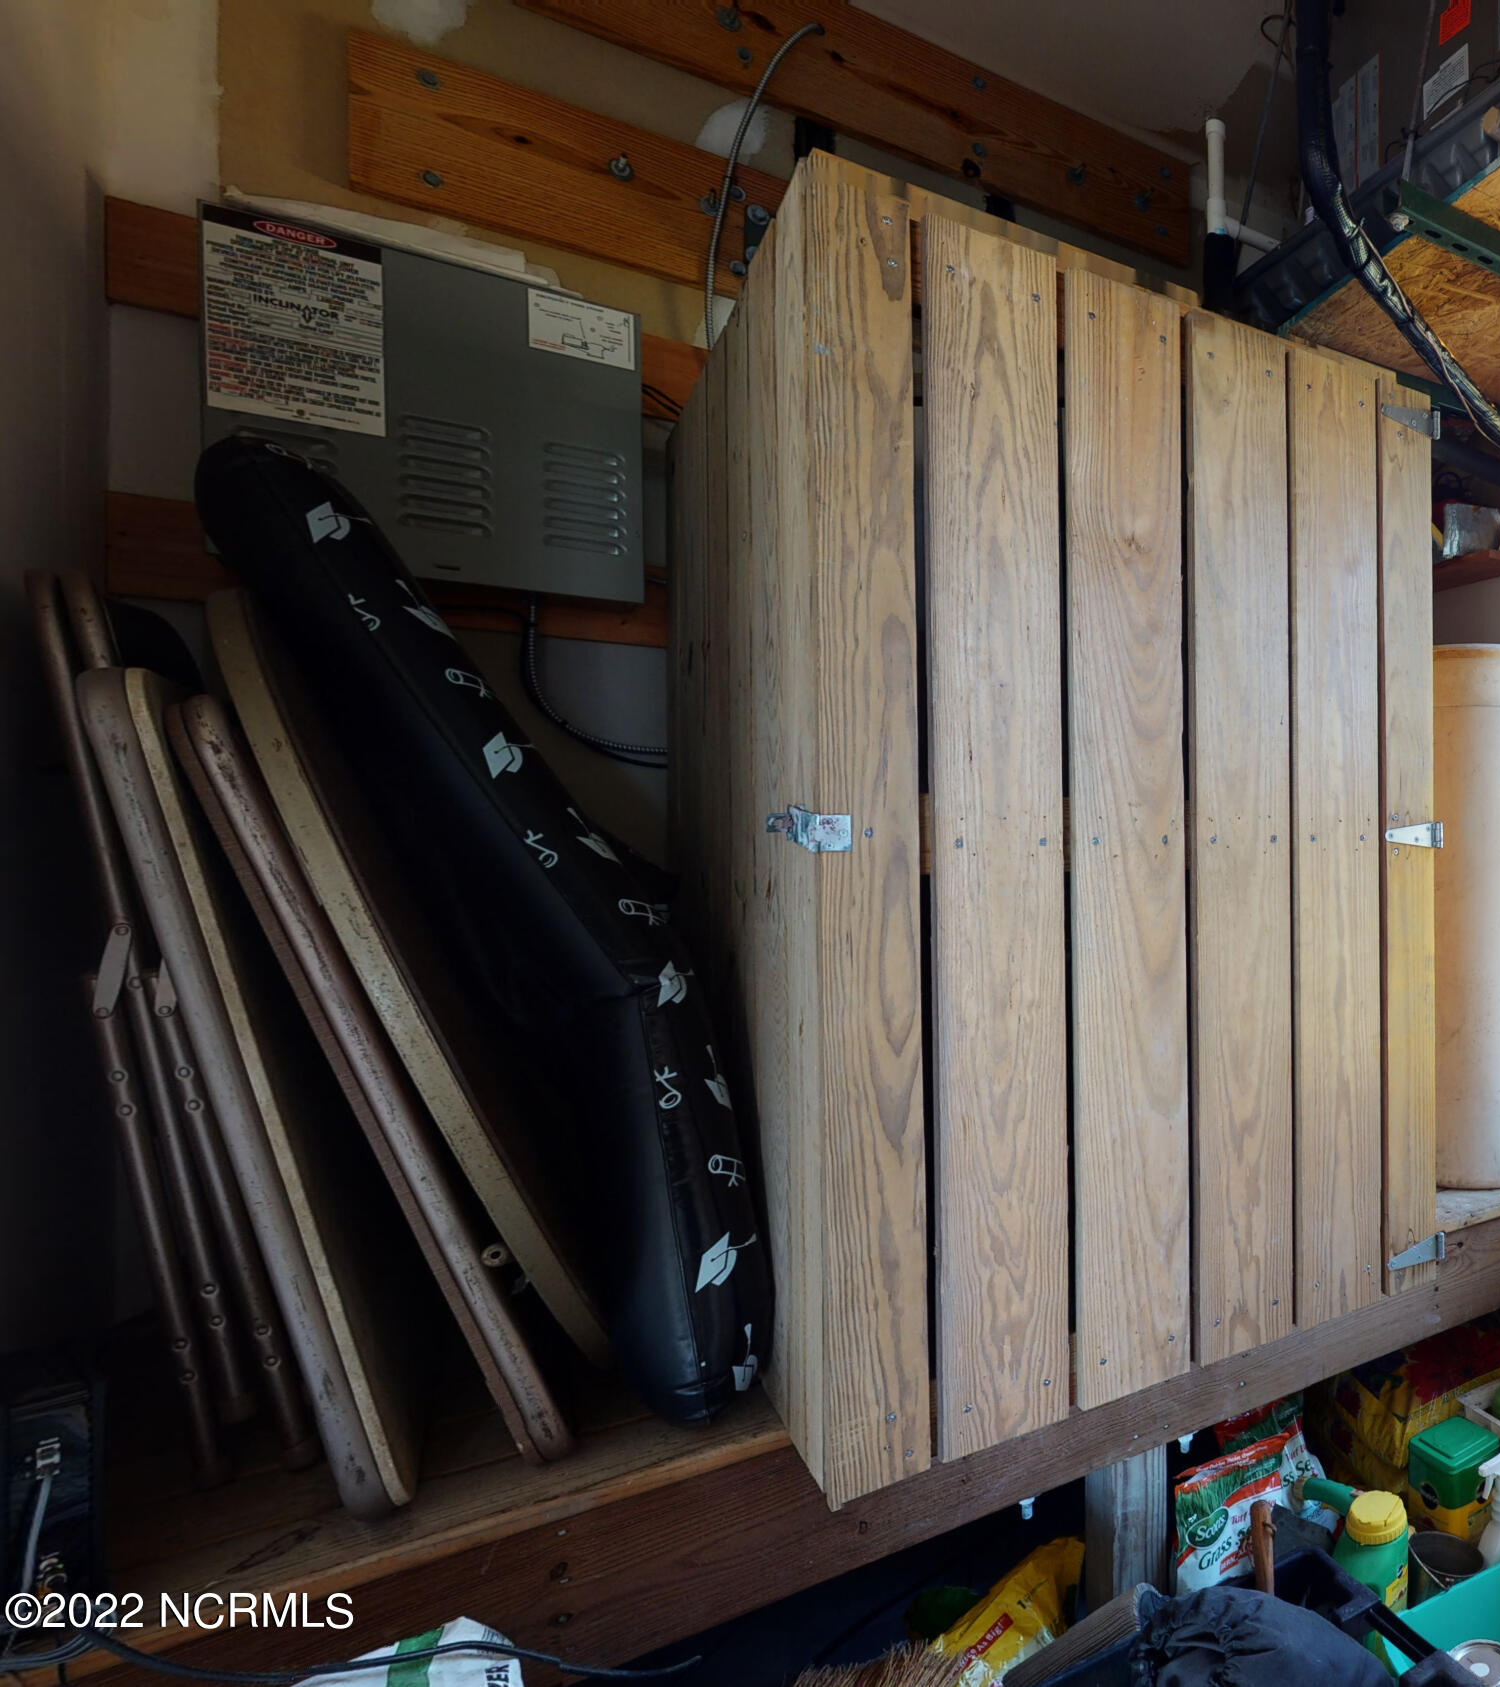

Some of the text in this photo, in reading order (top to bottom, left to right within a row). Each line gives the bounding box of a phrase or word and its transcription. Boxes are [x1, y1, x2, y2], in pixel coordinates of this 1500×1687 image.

[265, 223, 326, 245] DANGER
[253, 294, 339, 321] INCLINATOR
[1198, 1536, 1233, 1571] Grass
